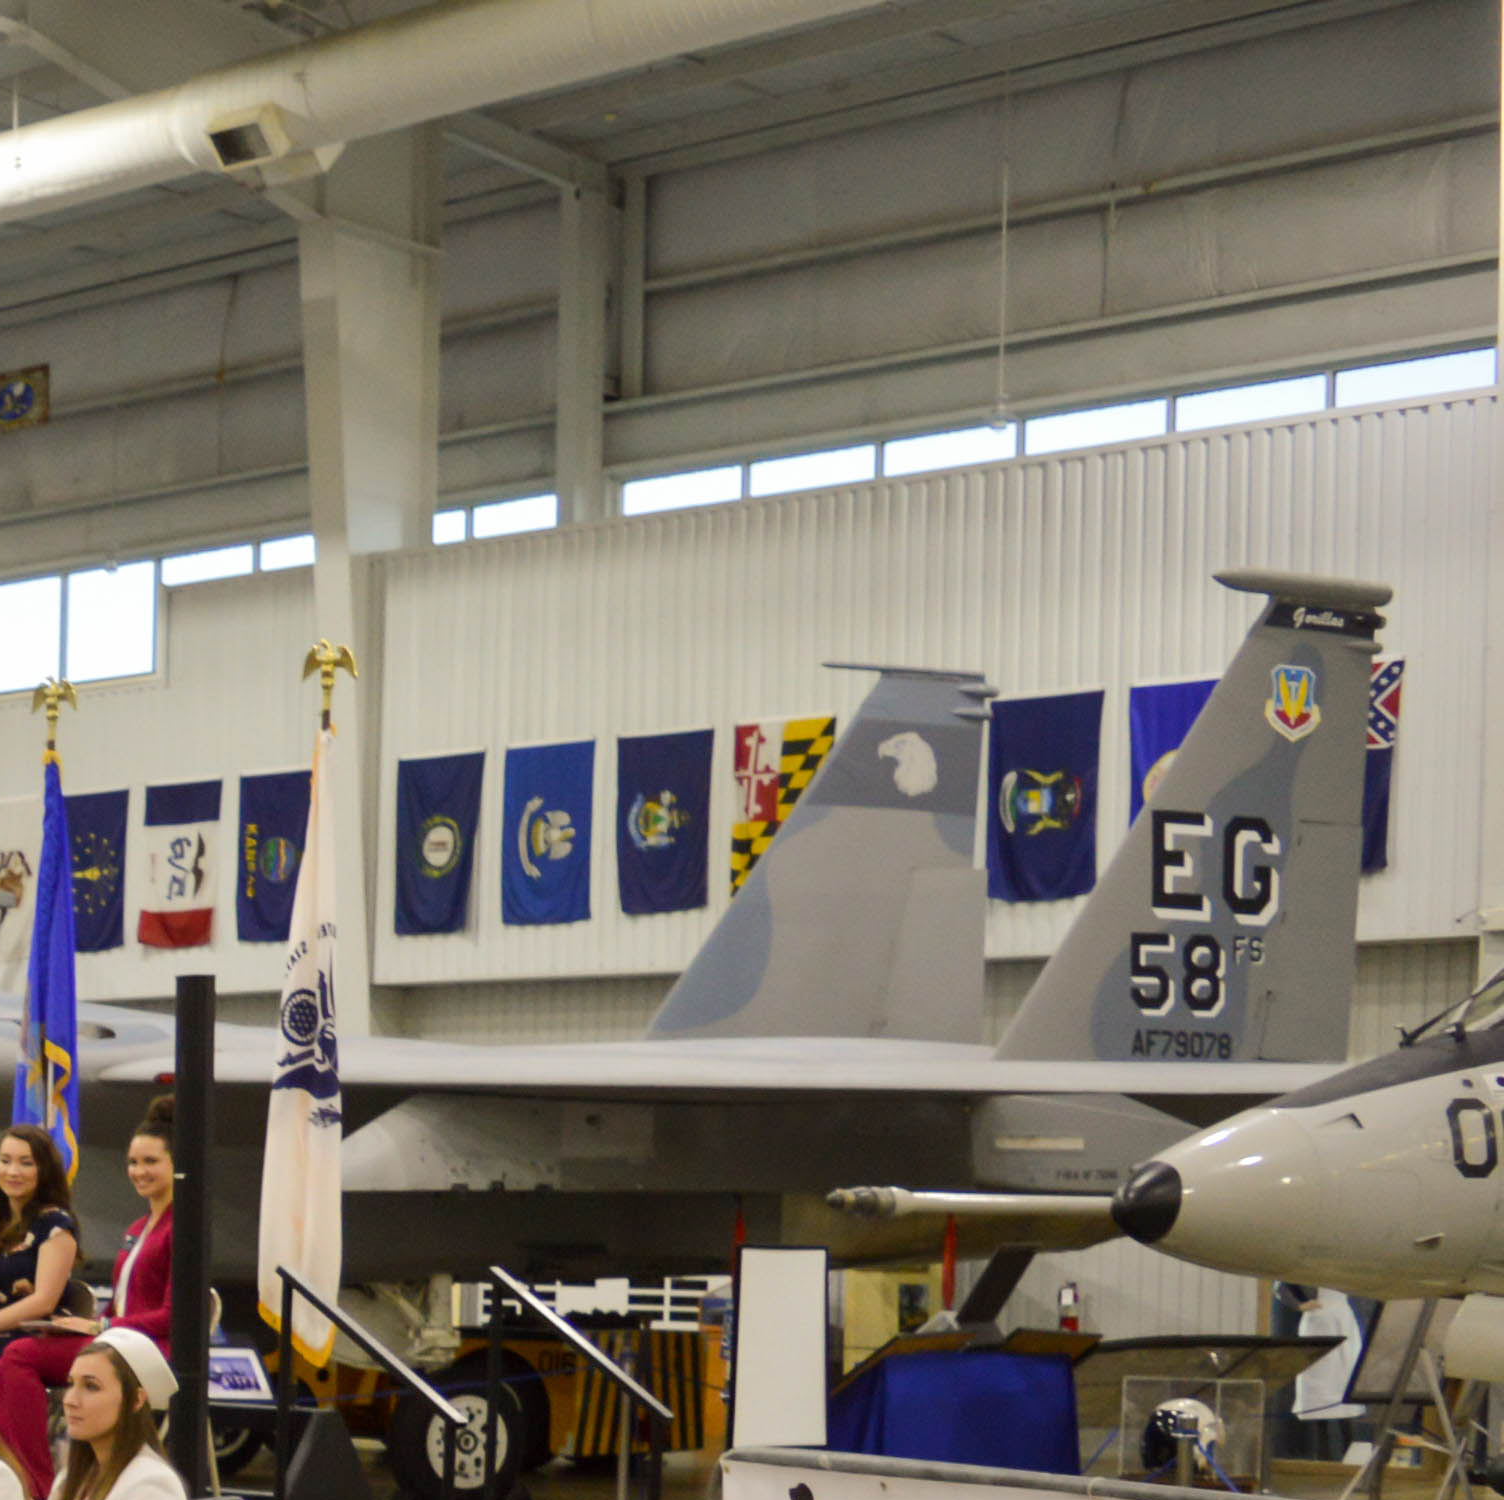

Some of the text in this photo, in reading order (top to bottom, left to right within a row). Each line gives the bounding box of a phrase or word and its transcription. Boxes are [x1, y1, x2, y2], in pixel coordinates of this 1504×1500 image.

[1152, 810, 1281, 927] EG
[1130, 932, 1266, 1018] 58 FS
[1130, 1029, 1233, 1060] AF79078
